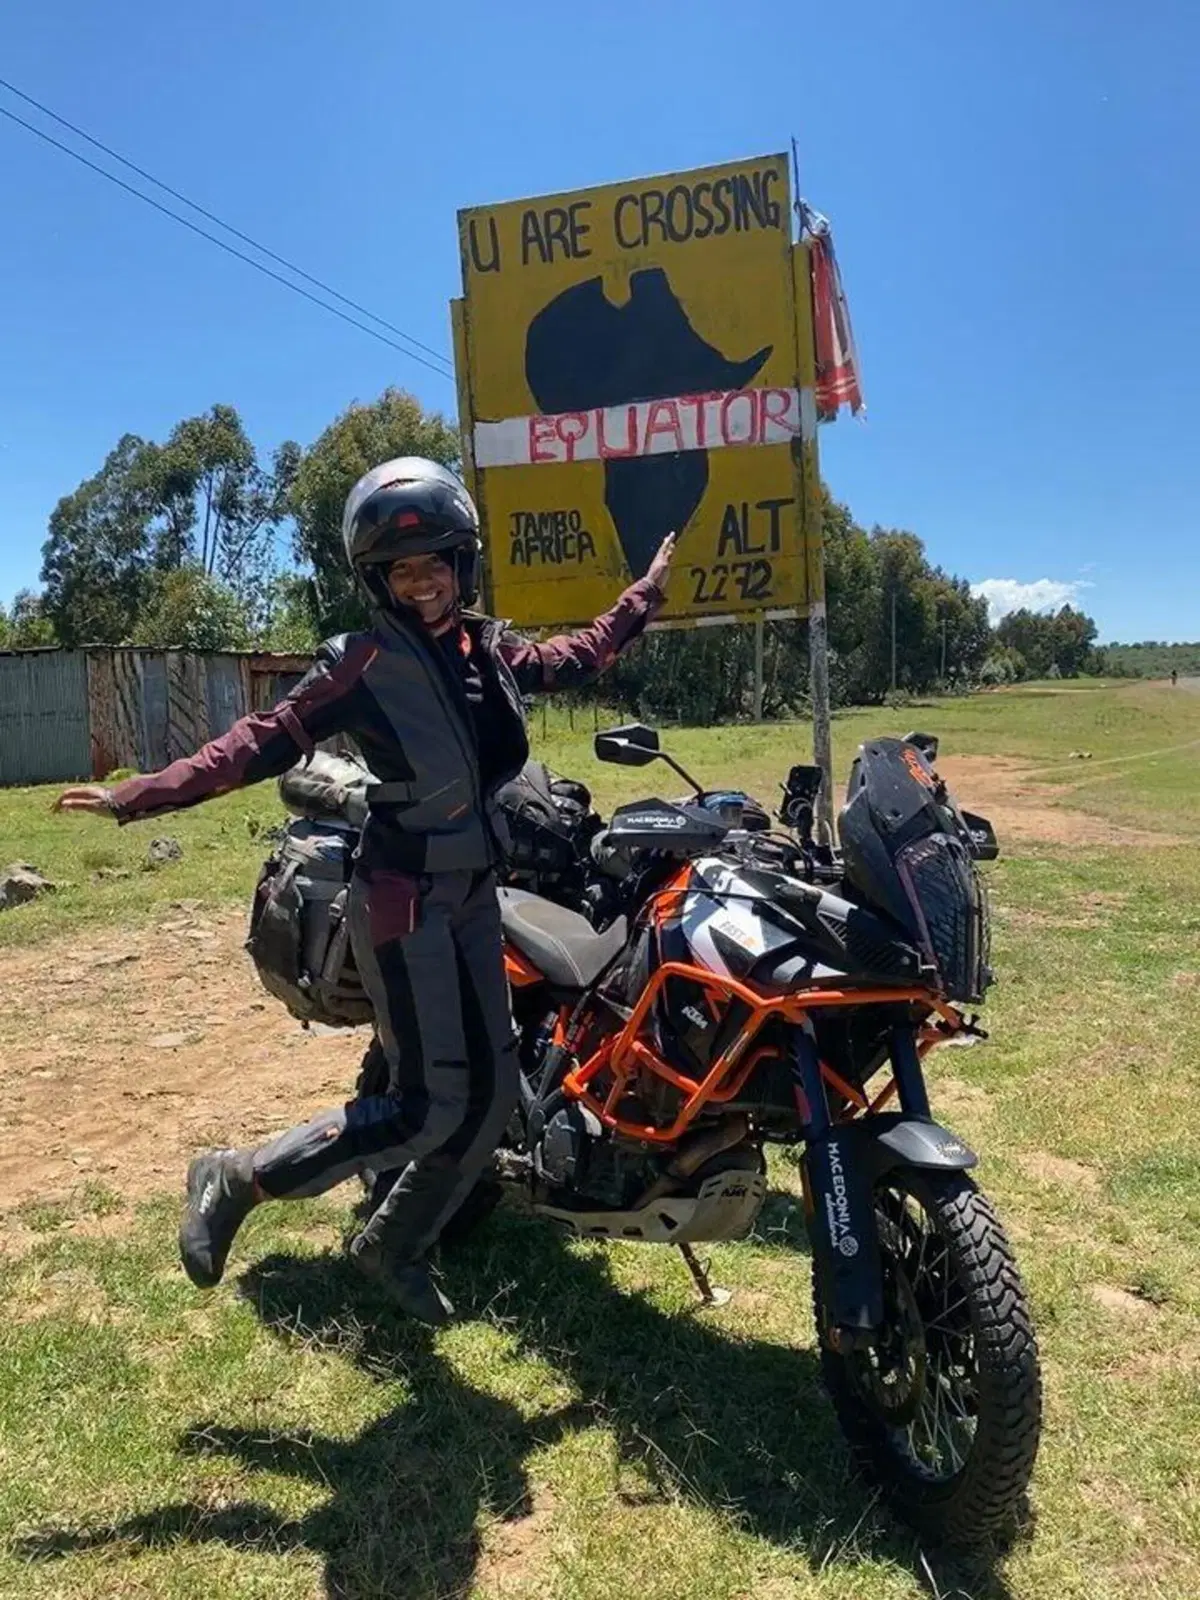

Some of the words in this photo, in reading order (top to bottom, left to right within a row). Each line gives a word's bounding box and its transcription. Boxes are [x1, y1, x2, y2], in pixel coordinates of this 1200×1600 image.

[469, 216, 500, 272] U
[522, 202, 593, 265] ARE
[614, 169, 780, 249] CROSSING
[529, 388, 801, 463] EQUATOR
[510, 509, 581, 537] JAMBO
[511, 531, 597, 567] AFRICA
[718, 498, 796, 557] ALT
[690, 559, 774, 603] 2272
[827, 1141, 851, 1236] MACEDONIA
